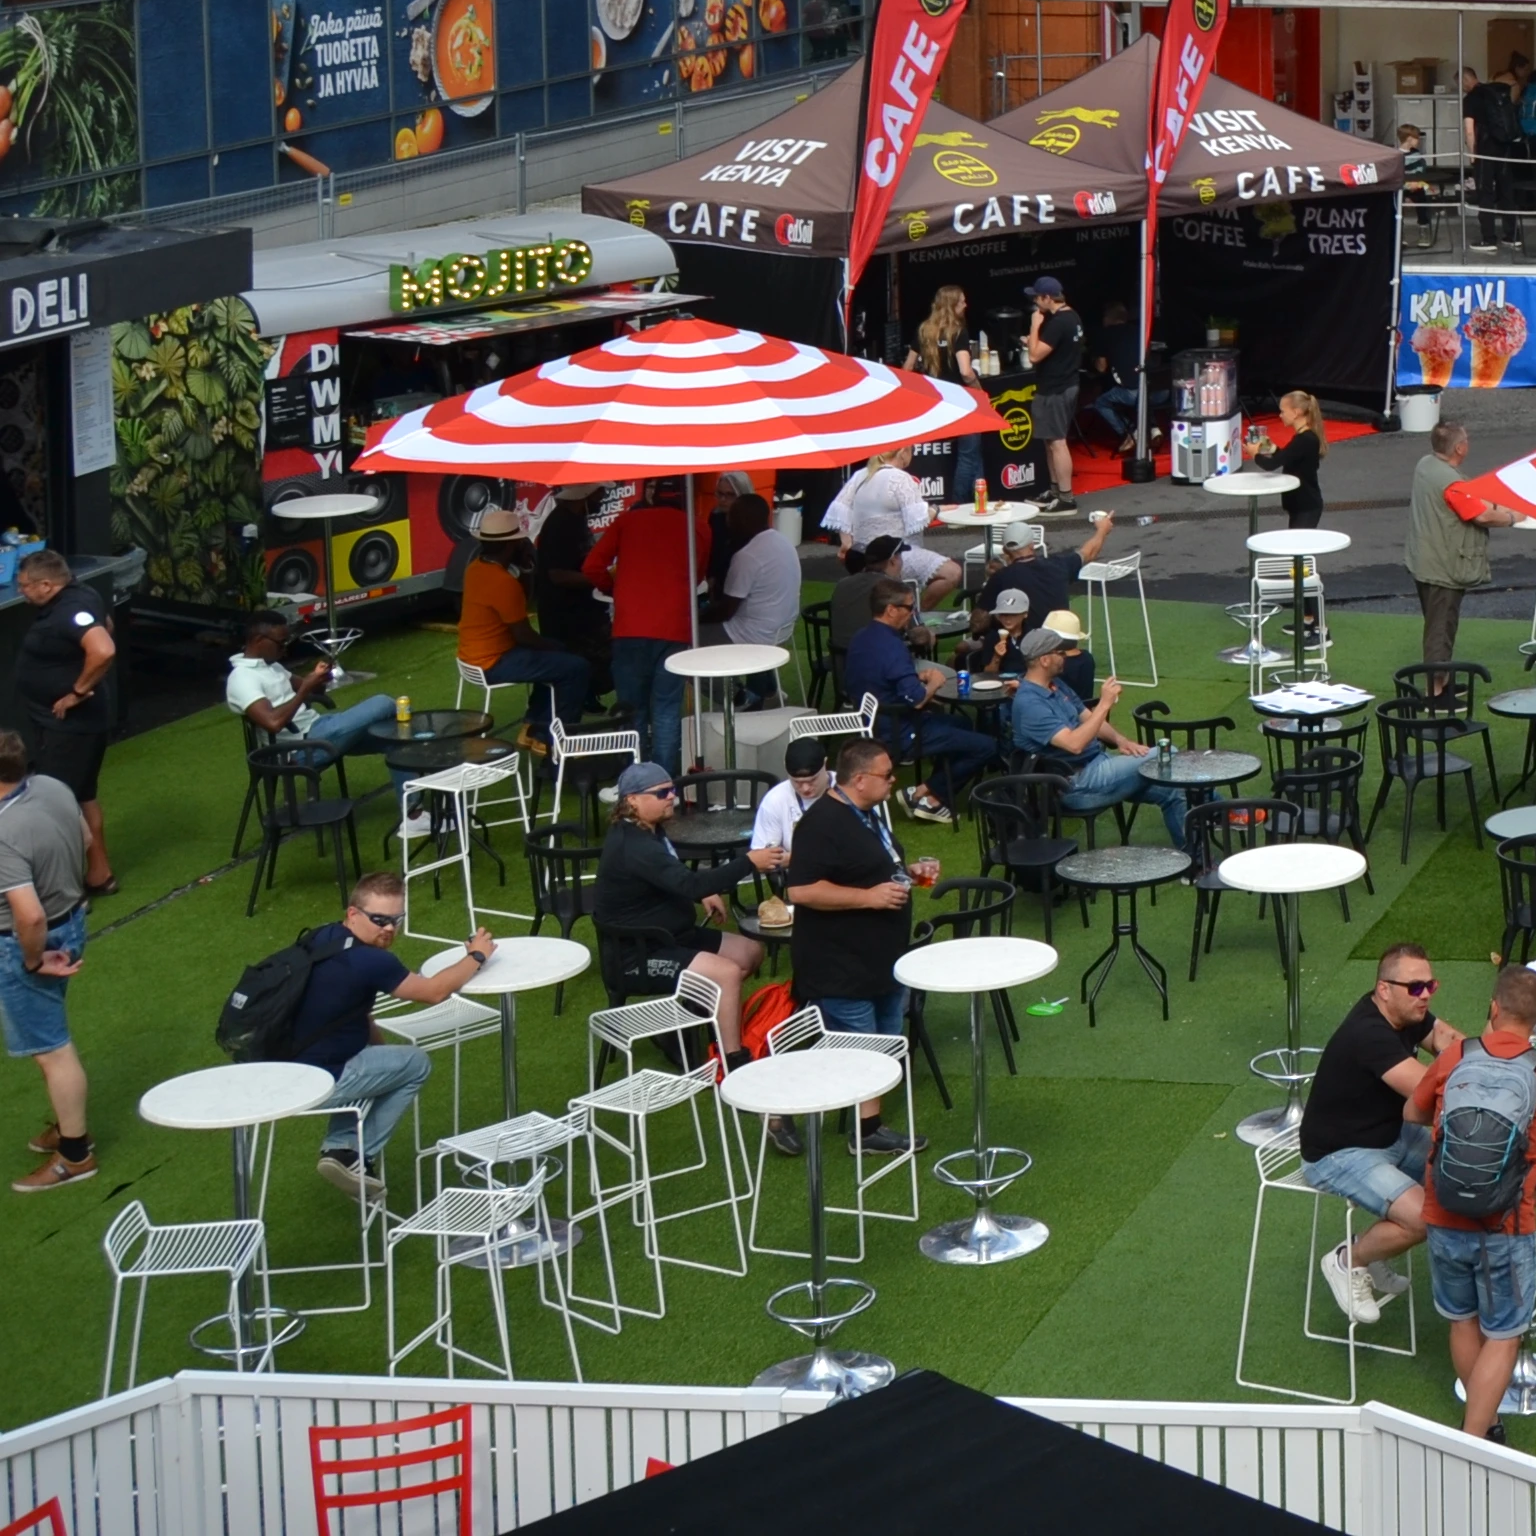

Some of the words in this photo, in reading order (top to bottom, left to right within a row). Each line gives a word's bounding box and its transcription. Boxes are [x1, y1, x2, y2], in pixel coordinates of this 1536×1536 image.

[310, 12, 345, 44] Joka
[315, 35, 379, 68] TUORETTA
[318, 73, 334, 98] JA
[336, 59, 379, 95] HYVÄÄ
[865, 20, 941, 188] CAFE
[1188, 109, 1268, 137] VISIT
[734, 138, 828, 164] VISIT
[1200, 134, 1292, 157] KENYA
[700, 165, 792, 187] KENYA
[1236, 166, 1326, 200] CAFE
[668, 202, 760, 242] CAFE
[953, 194, 1056, 234] CAFE
[1303, 206, 1368, 229] PLANT
[1076, 231, 1088, 242] IN
[1091, 226, 1130, 242] KENYA
[1173, 218, 1247, 248] COFFEE
[1309, 234, 1367, 256] TREES
[909, 244, 960, 263] KENYAN
[962, 241, 1008, 257] COFFEE
[392, 239, 594, 312] MOJITO
[12, 273, 88, 334] DELI
[1409, 280, 1505, 324] KAHVI
[914, 441, 952, 456] FFEE
